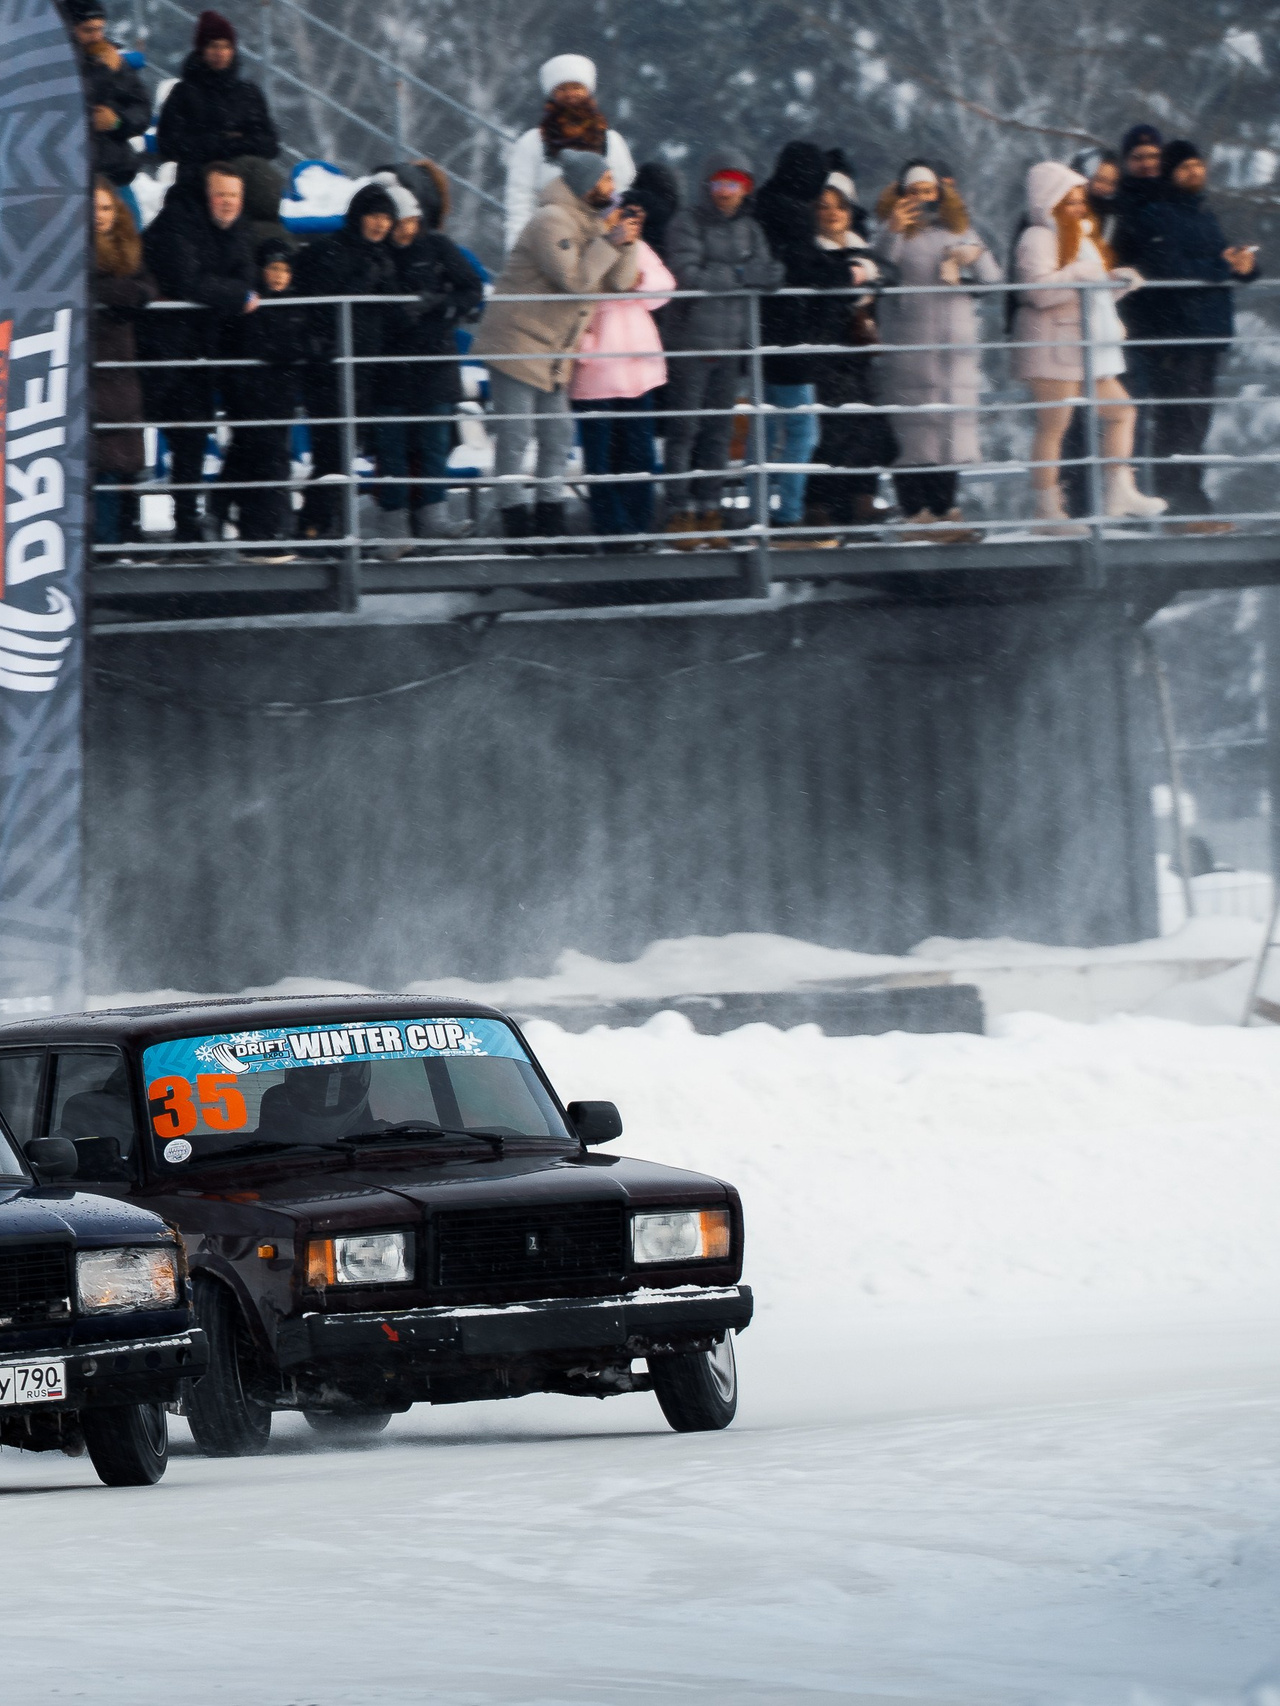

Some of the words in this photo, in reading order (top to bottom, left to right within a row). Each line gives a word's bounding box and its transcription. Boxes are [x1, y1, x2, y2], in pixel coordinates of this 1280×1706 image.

[234, 1039, 286, 1057] DRIFT
[287, 1026, 404, 1060] WINTER
[405, 1024, 465, 1050] CUP
[263, 1051, 285, 1059] EXPO
[148, 1073, 247, 1138] 35
[18, 1367, 58, 1391] 790
[27, 1389, 47, 1398] RUS
